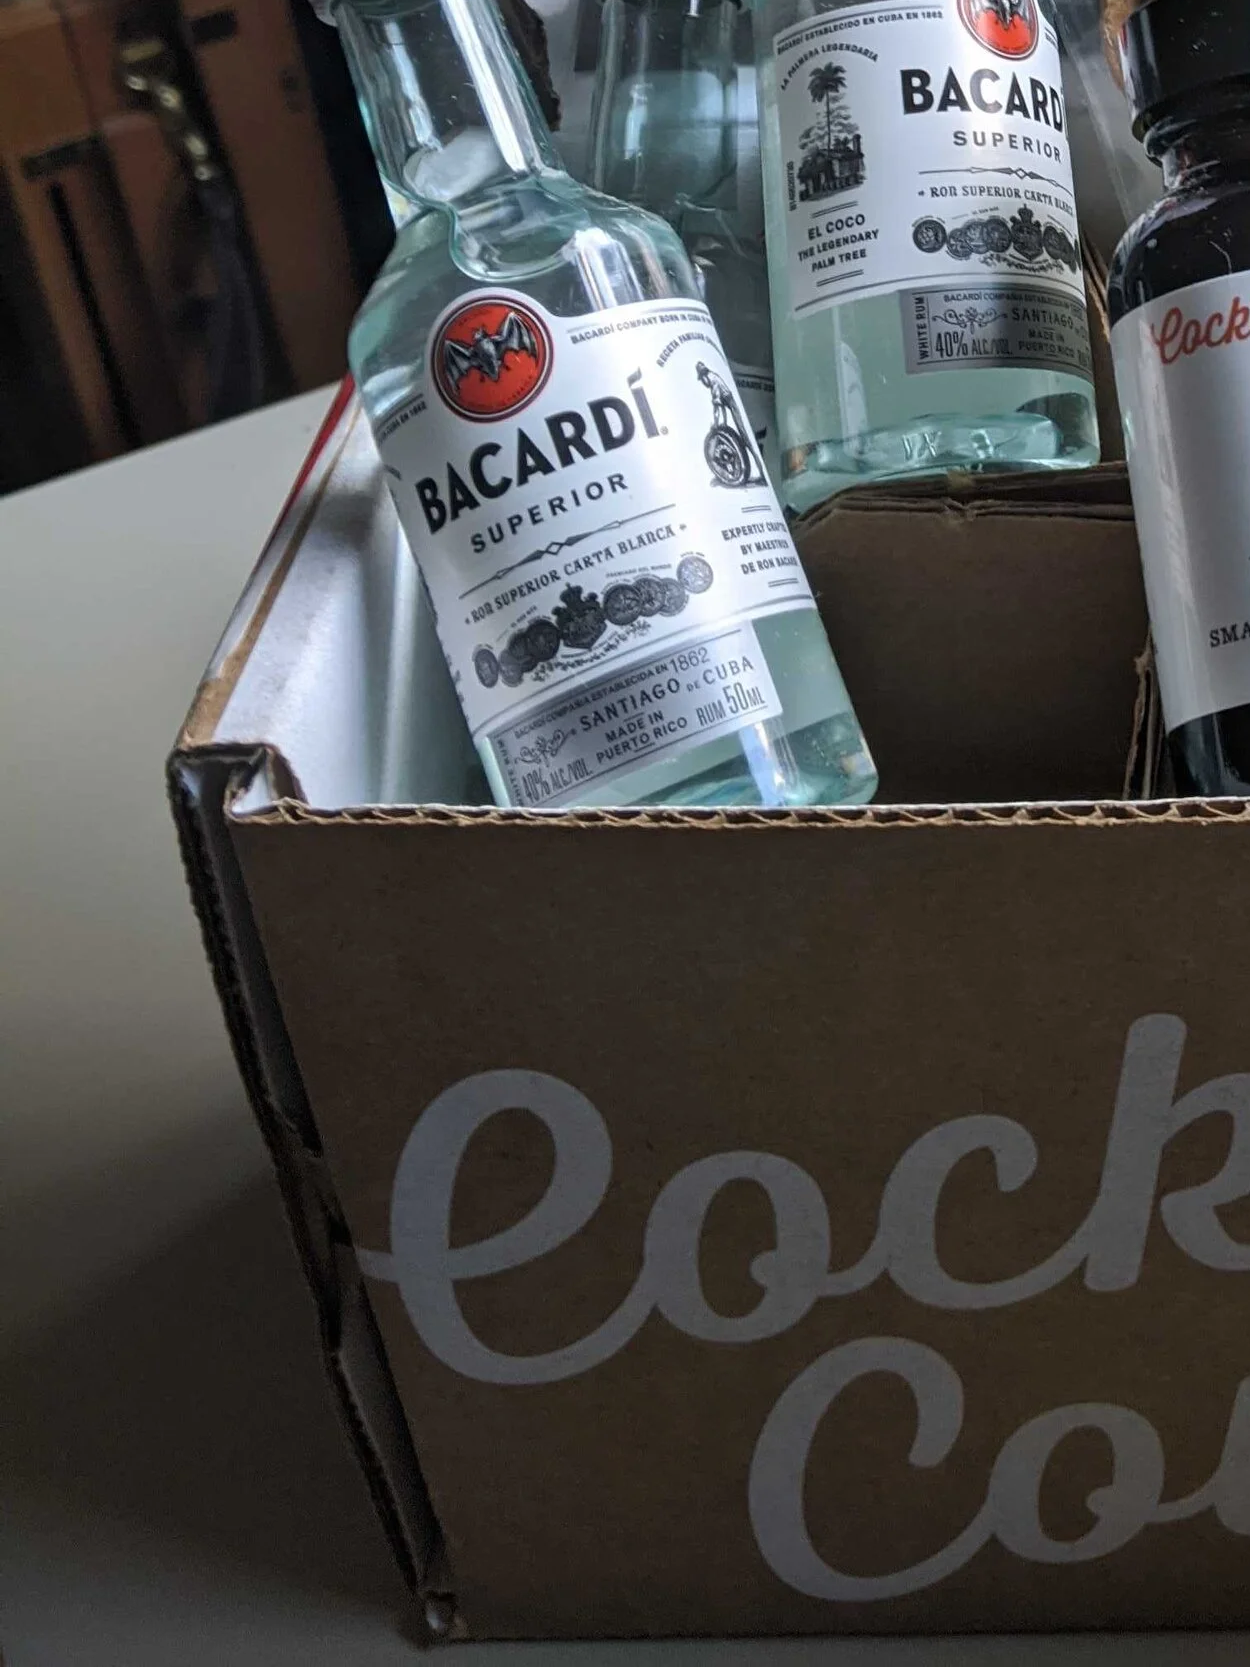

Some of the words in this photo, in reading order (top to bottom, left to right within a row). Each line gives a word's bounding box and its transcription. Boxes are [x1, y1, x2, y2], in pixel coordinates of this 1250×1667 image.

[863, 17, 876, 26] EN
[878, 14, 903, 23] CUBA
[906, 12, 919, 20] EN
[822, 43, 878, 63] LEGENDARIA
[900, 66, 1066, 137] BACARD
[953, 130, 1061, 164] SUPERIOR
[962, 185, 1022, 199] SUPERIOR
[1024, 188, 1052, 205] CARTA
[808, 225, 822, 241] EL
[825, 214, 866, 234] COCO
[798, 246, 815, 262] THE
[817, 229, 880, 254] LEGENDARY
[811, 256, 835, 273] PALM
[838, 248, 867, 264] TREE
[914, 295, 926, 320] RUM
[943, 291, 983, 303] BACARDÍ
[570, 323, 615, 345] BACARDÍ
[616, 318, 658, 332] COMPANY
[1011, 307, 1074, 330] SANTIAGO
[656, 337, 680, 368] RECETA
[917, 325, 930, 360] WHITE
[935, 331, 969, 358] 40%
[415, 367, 660, 535] BACARDÍ
[470, 472, 629, 554] SUPERIOR
[721, 521, 765, 542] EXPERTLY
[740, 542, 753, 556] BY
[494, 570, 562, 612] SUPERIOR
[564, 548, 615, 576] CARTA
[618, 523, 676, 555] BLANCA
[740, 561, 757, 576] DE
[756, 558, 776, 571] RON
[590, 670, 656, 702] ESTABLECIDA
[655, 664, 669, 677] EN
[669, 647, 710, 674] 1862
[579, 678, 681, 732] SANTIAGO
[686, 681, 699, 693] DE
[702, 655, 754, 685] CUBA
[596, 734, 650, 765] PUERTO
[652, 716, 688, 740] RICO
[695, 699, 724, 728] RUM
[605, 718, 645, 744] MADE
[648, 709, 665, 726] IN
